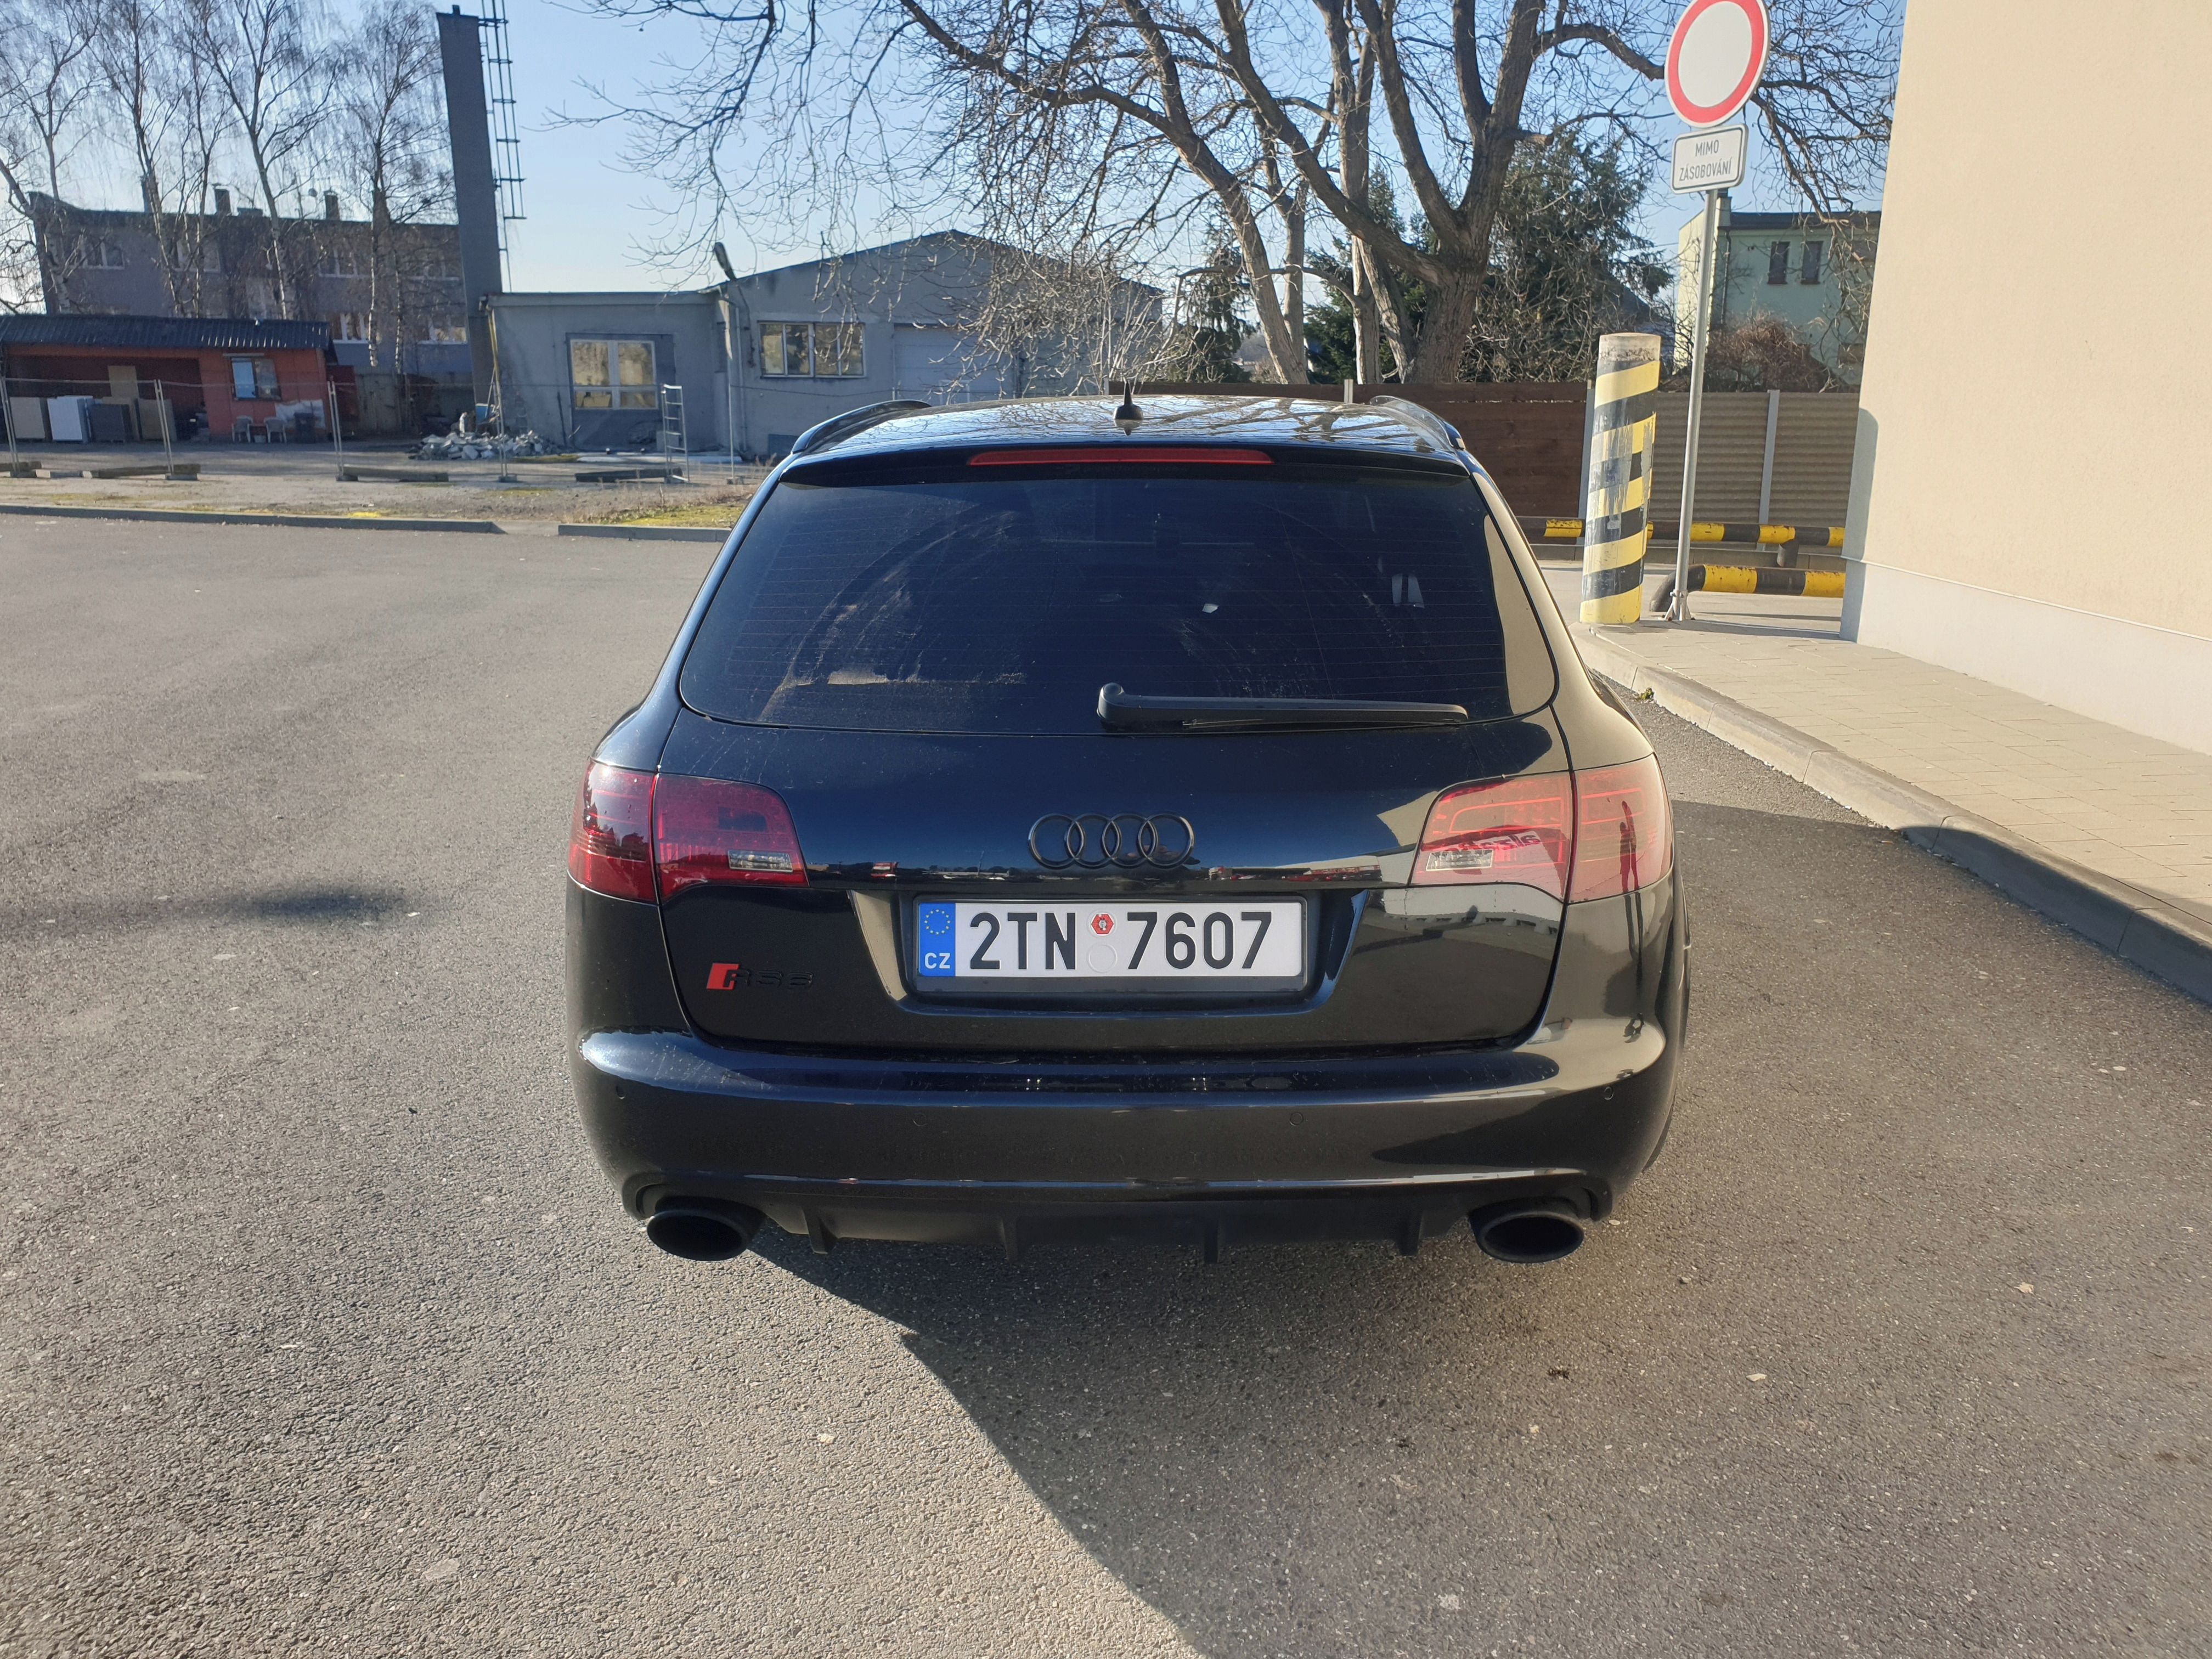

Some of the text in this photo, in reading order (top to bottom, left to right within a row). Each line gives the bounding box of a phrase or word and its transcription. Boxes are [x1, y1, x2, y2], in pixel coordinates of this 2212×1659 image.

[1695, 139, 1719, 157] MIMO
[1679, 156, 1733, 182] ZÁSOBOVÁNÍ
[970, 912, 1272, 970] 2TN 7607
[924, 952, 950, 969] CZ
